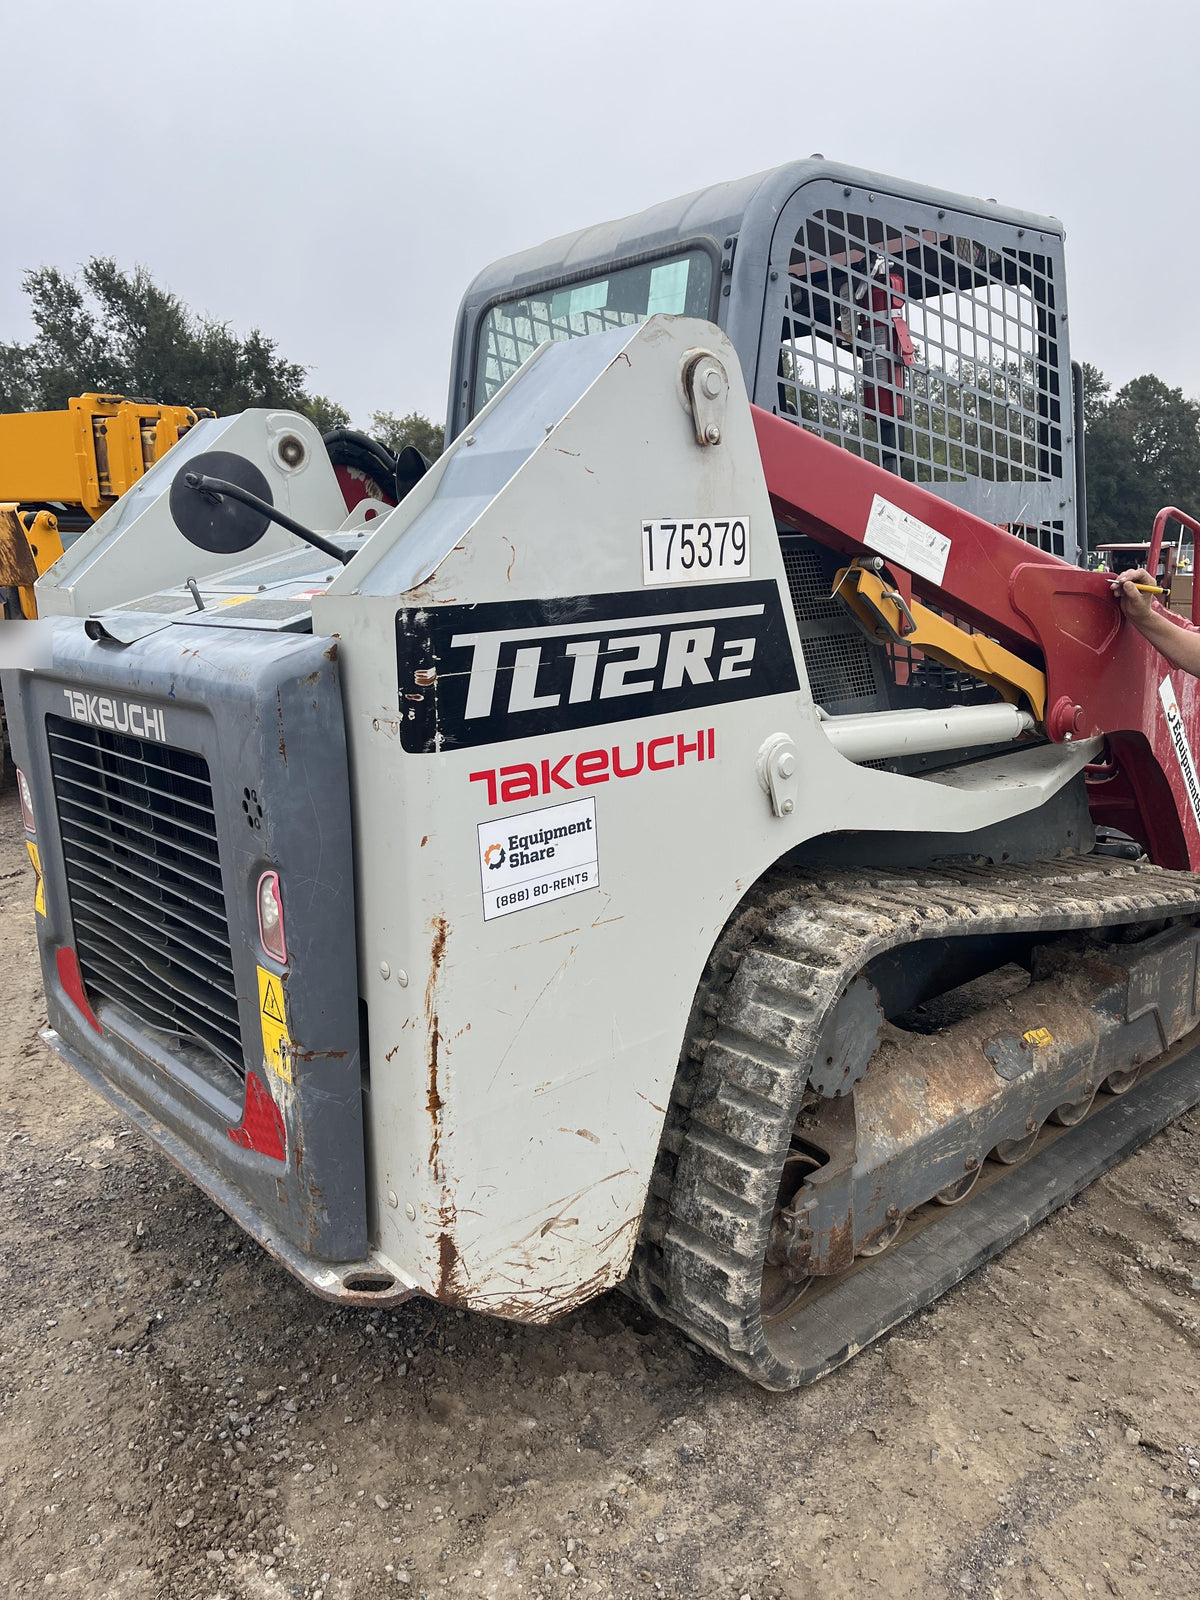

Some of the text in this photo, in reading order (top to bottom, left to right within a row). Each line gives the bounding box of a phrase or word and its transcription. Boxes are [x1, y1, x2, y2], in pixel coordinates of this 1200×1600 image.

[643, 521, 746, 571] 175379
[450, 604, 765, 720] TL12R2
[63, 689, 166, 742] TAKEUCHI
[469, 728, 715, 805] TAKEUCHI
[508, 818, 592, 851] Equipment
[509, 846, 555, 869] Share
[496, 871, 589, 909] (888) 80-RENTS
